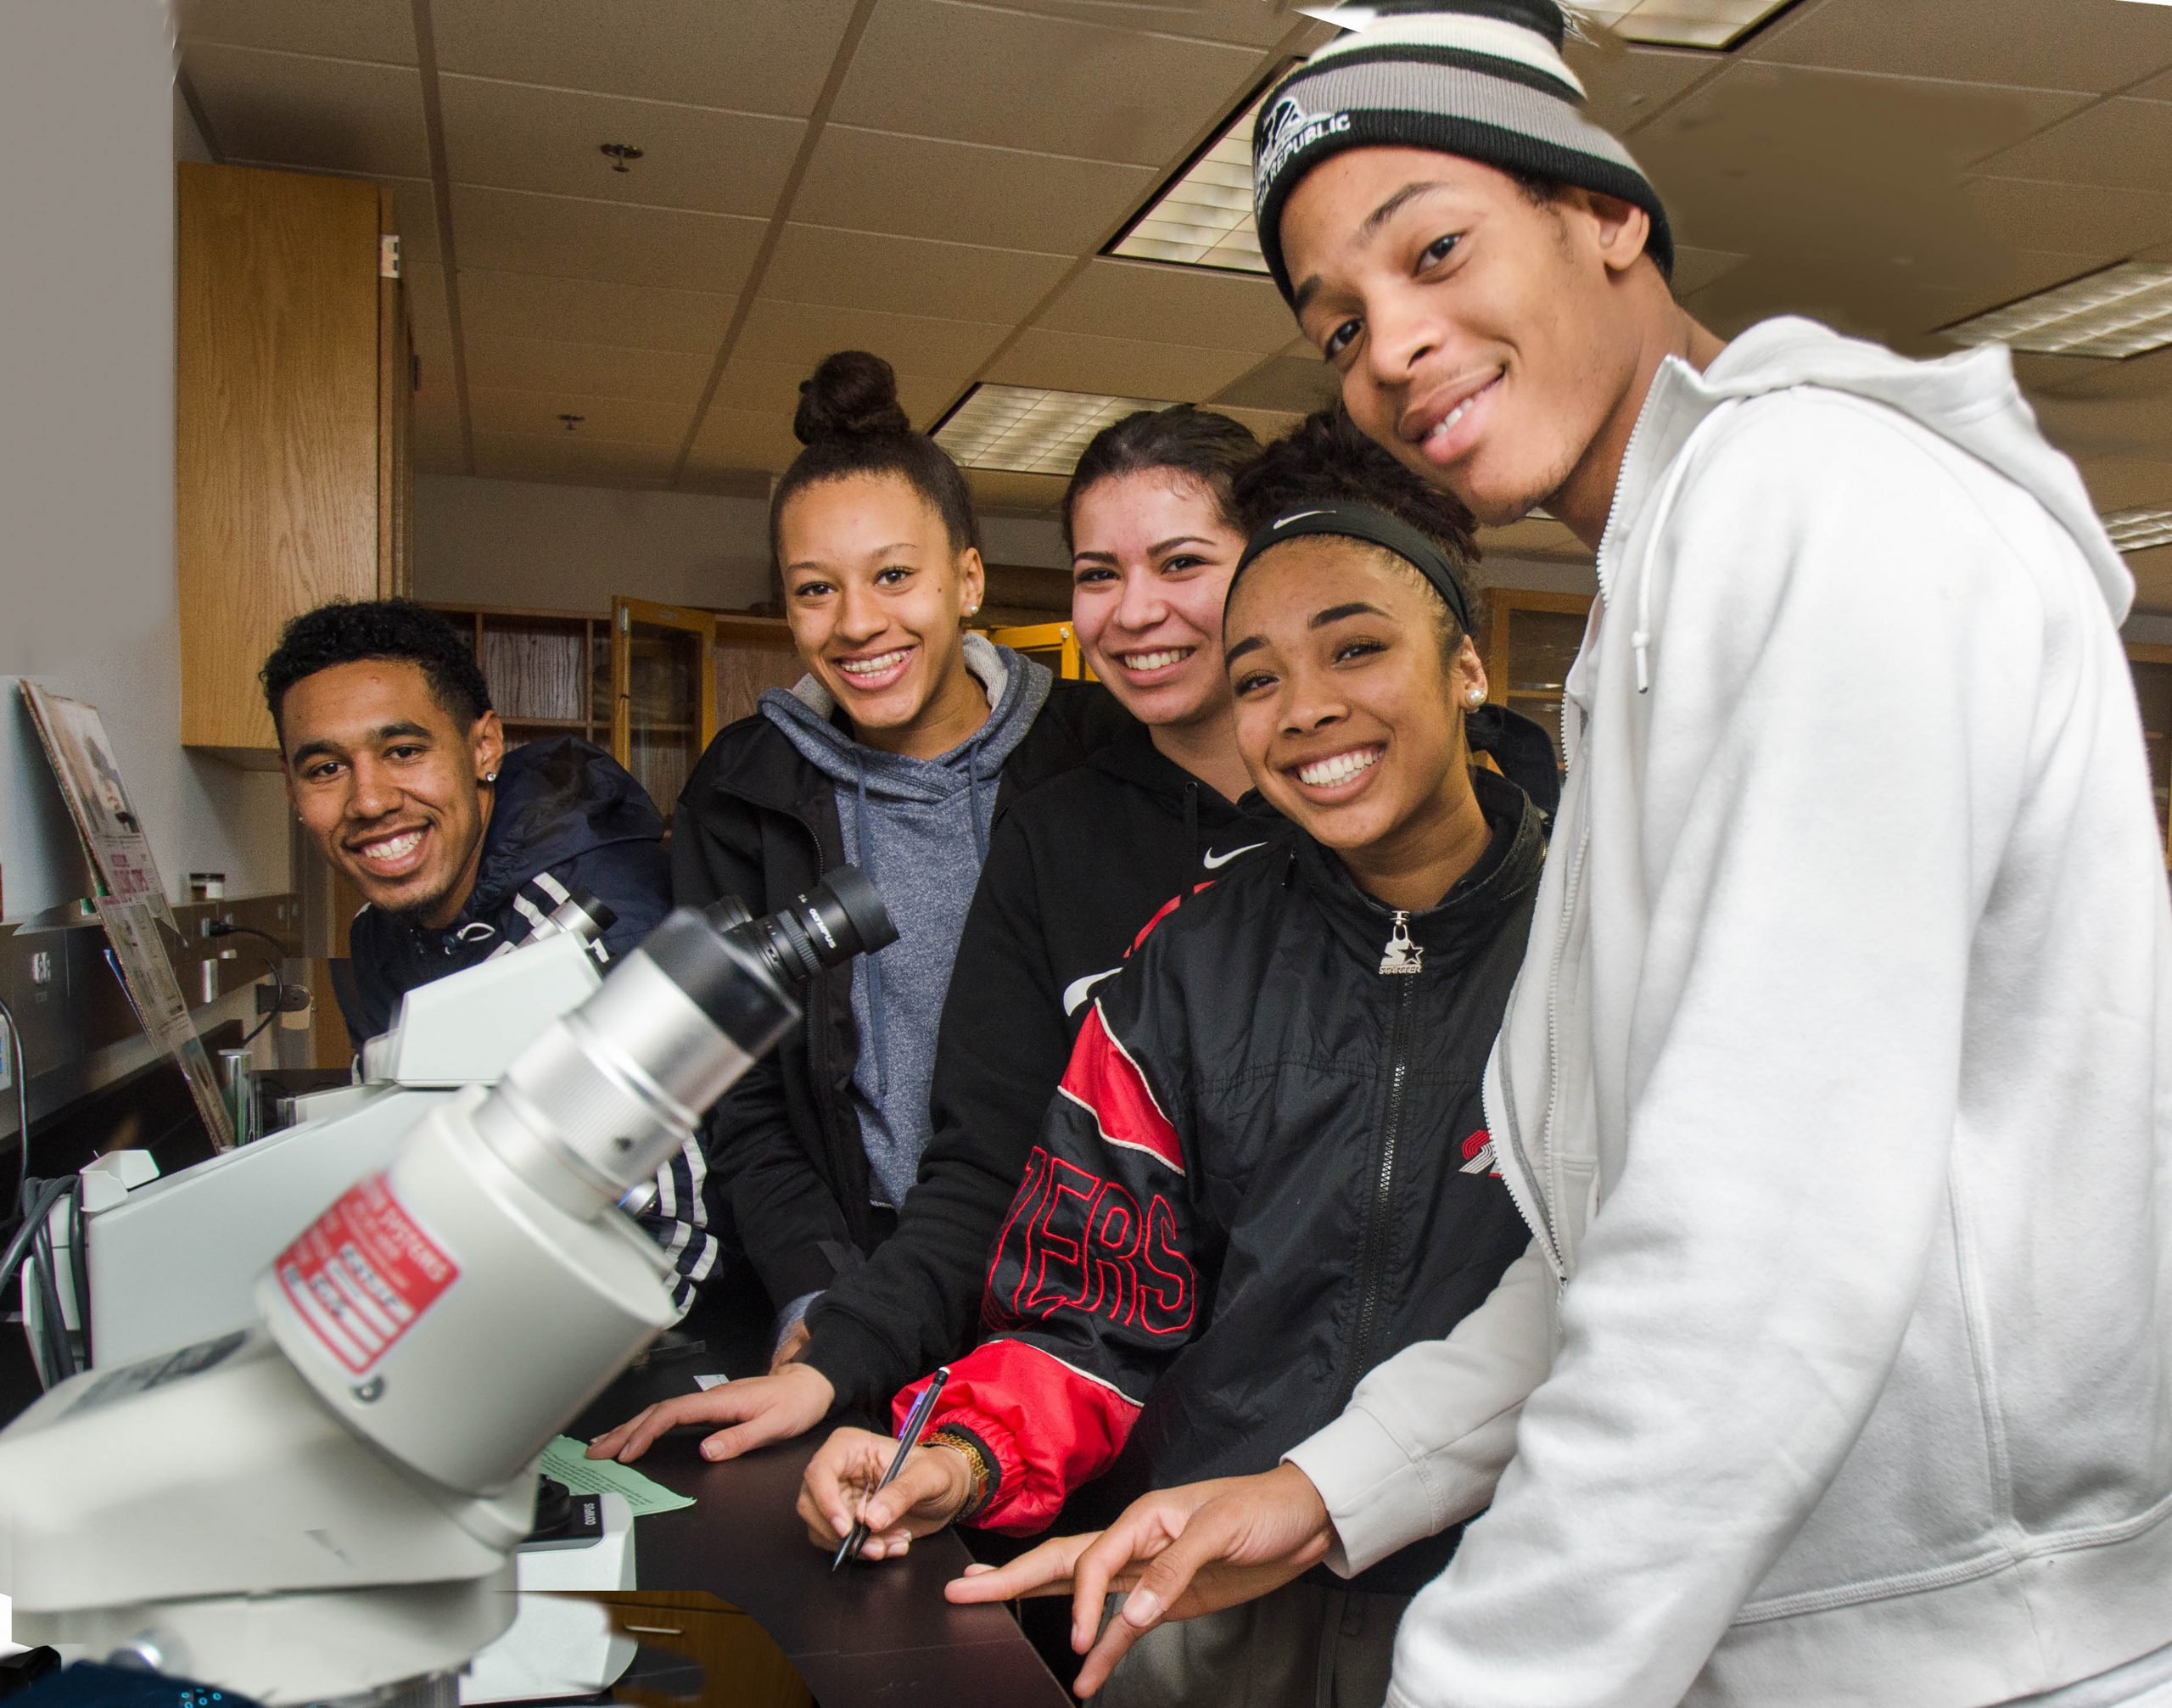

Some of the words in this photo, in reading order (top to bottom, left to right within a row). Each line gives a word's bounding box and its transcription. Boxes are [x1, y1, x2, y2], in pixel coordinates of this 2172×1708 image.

[1268, 113, 1351, 184] REPUBLIC
[809, 908, 837, 949] OLYMPUS
[1379, 965, 1421, 975] STARTER
[585, 1503, 596, 1526] OLYMPUS
